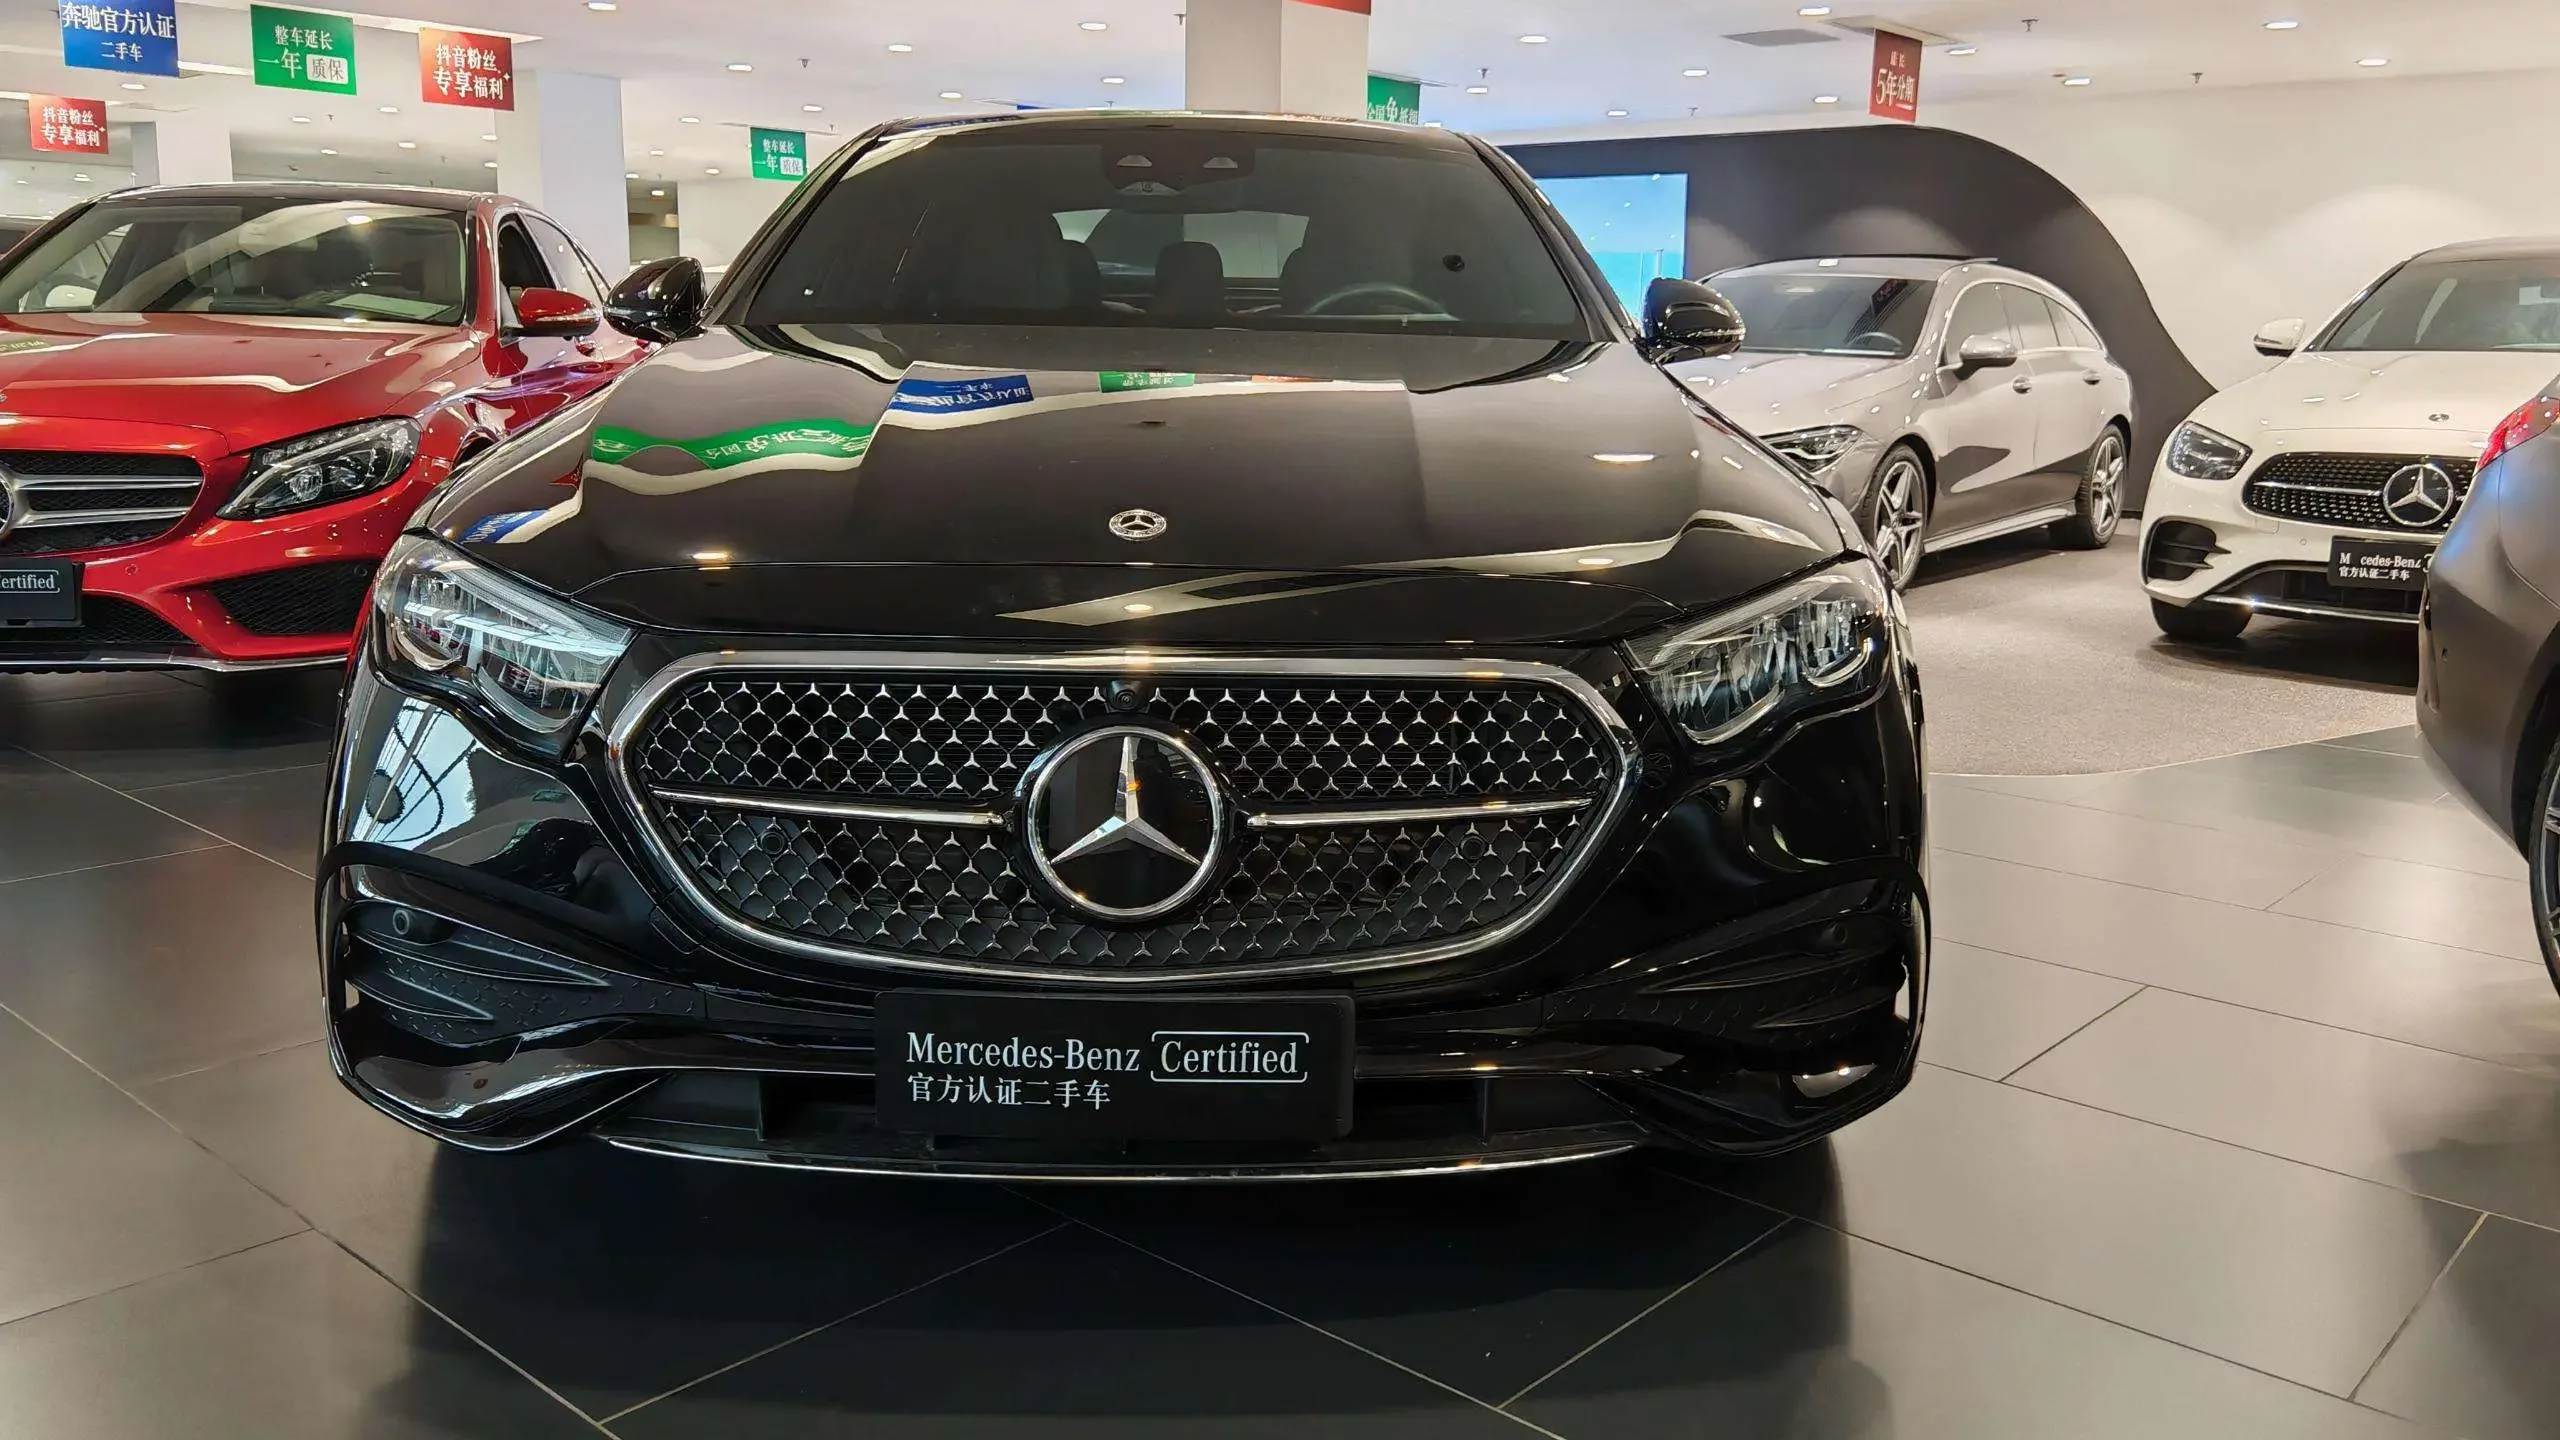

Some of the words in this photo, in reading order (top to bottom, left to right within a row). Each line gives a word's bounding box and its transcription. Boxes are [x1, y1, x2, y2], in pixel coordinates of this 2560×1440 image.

[61, 2, 176, 39] 奔驰官方认证
[100, 41, 143, 61] 二手车
[274, 24, 333, 50] 整车延长
[434, 43, 498, 72] 抖音粉丝
[432, 65, 504, 101] 专享福利
[0, 574, 55, 589] ertified
[2339, 565, 2411, 581] 官方认证二手车
[906, 1031, 1140, 1072] Mercedes-Benz
[1160, 1040, 1299, 1074] Certified
[907, 1071, 1111, 1111] 官方认证二手车
